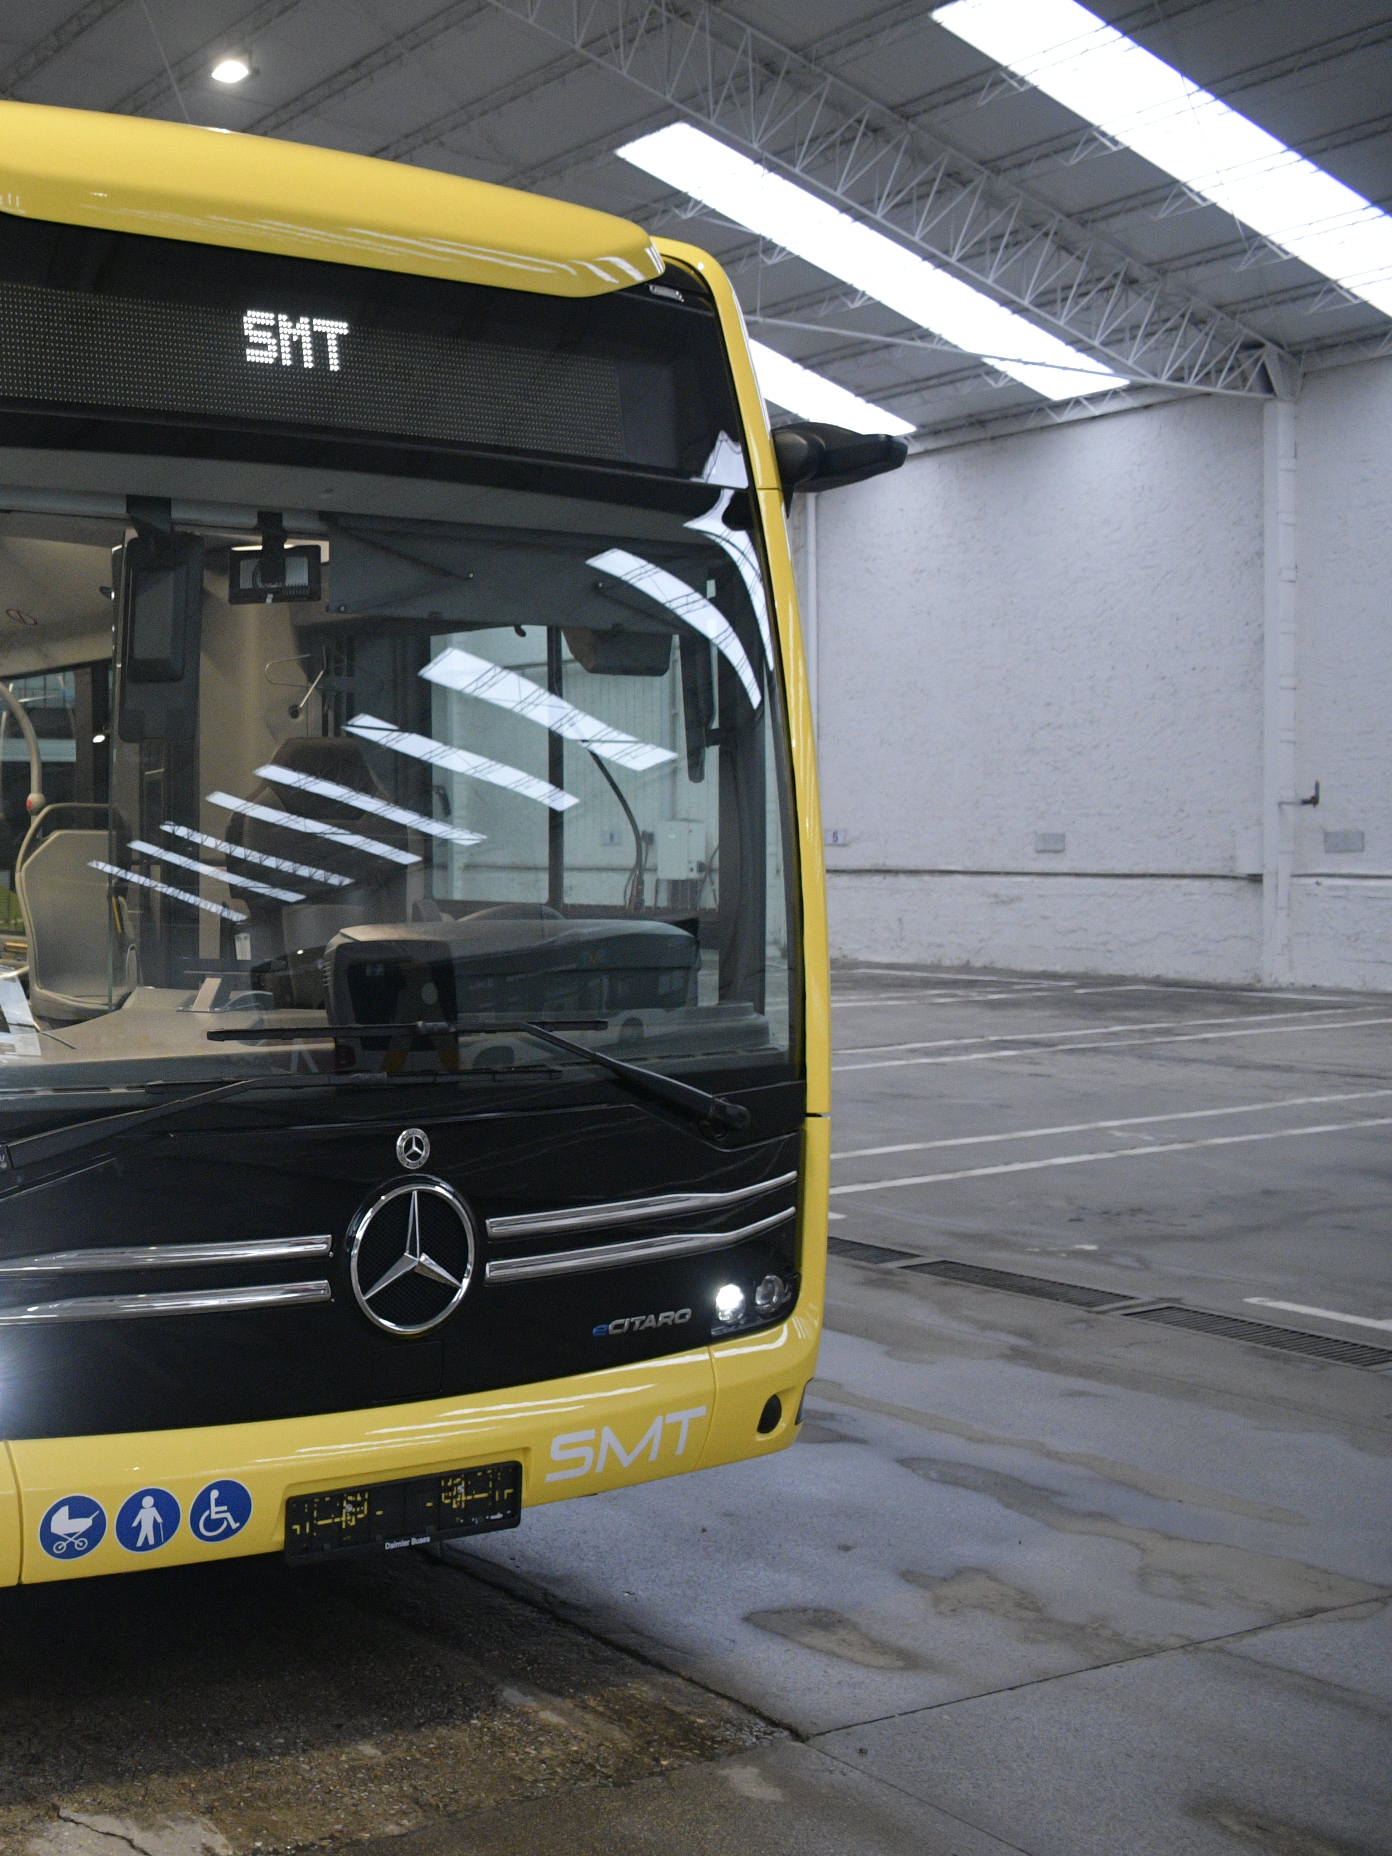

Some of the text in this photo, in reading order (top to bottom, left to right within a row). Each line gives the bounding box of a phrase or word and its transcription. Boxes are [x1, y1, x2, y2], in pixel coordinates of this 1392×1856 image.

[243, 310, 349, 371] SMT
[592, 1308, 692, 1336] eCITARO
[544, 1405, 707, 1483] SMT
[384, 1536, 431, 1550] Daimler Buses
